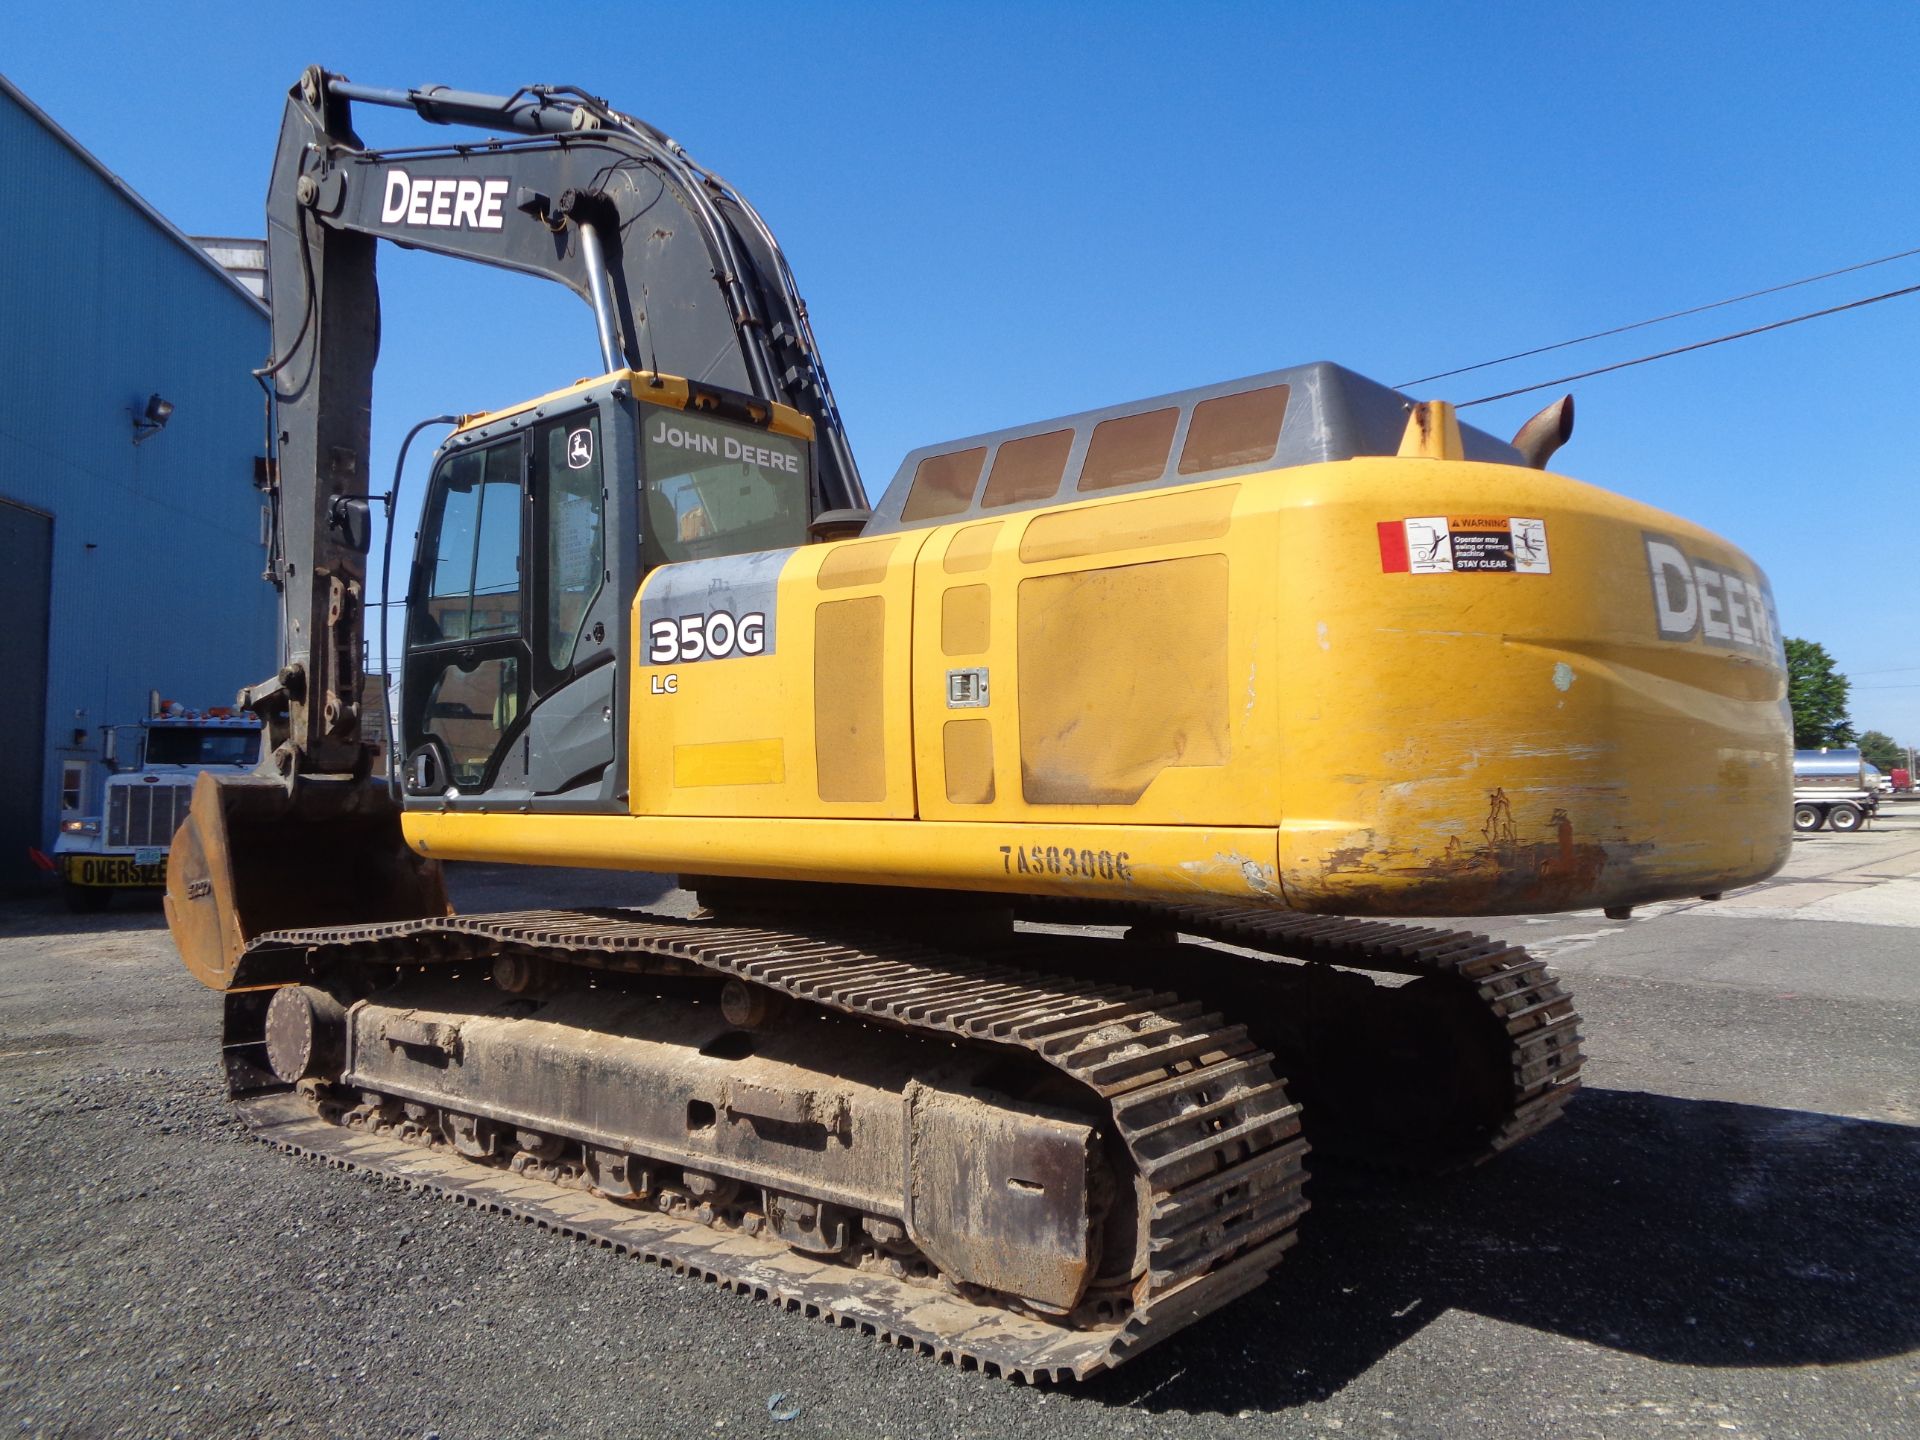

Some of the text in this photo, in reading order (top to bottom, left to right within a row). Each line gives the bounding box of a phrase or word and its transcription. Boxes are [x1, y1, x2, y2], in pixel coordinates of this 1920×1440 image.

[381, 170, 508, 228] DEERE
[653, 422, 798, 473] JOHN DEERE
[1461, 519, 1508, 528] WARNING
[1454, 536, 1484, 544] Operator
[1457, 560, 1508, 568] STAY CLEAR
[650, 611, 765, 664] 350G
[651, 674, 678, 694] LC
